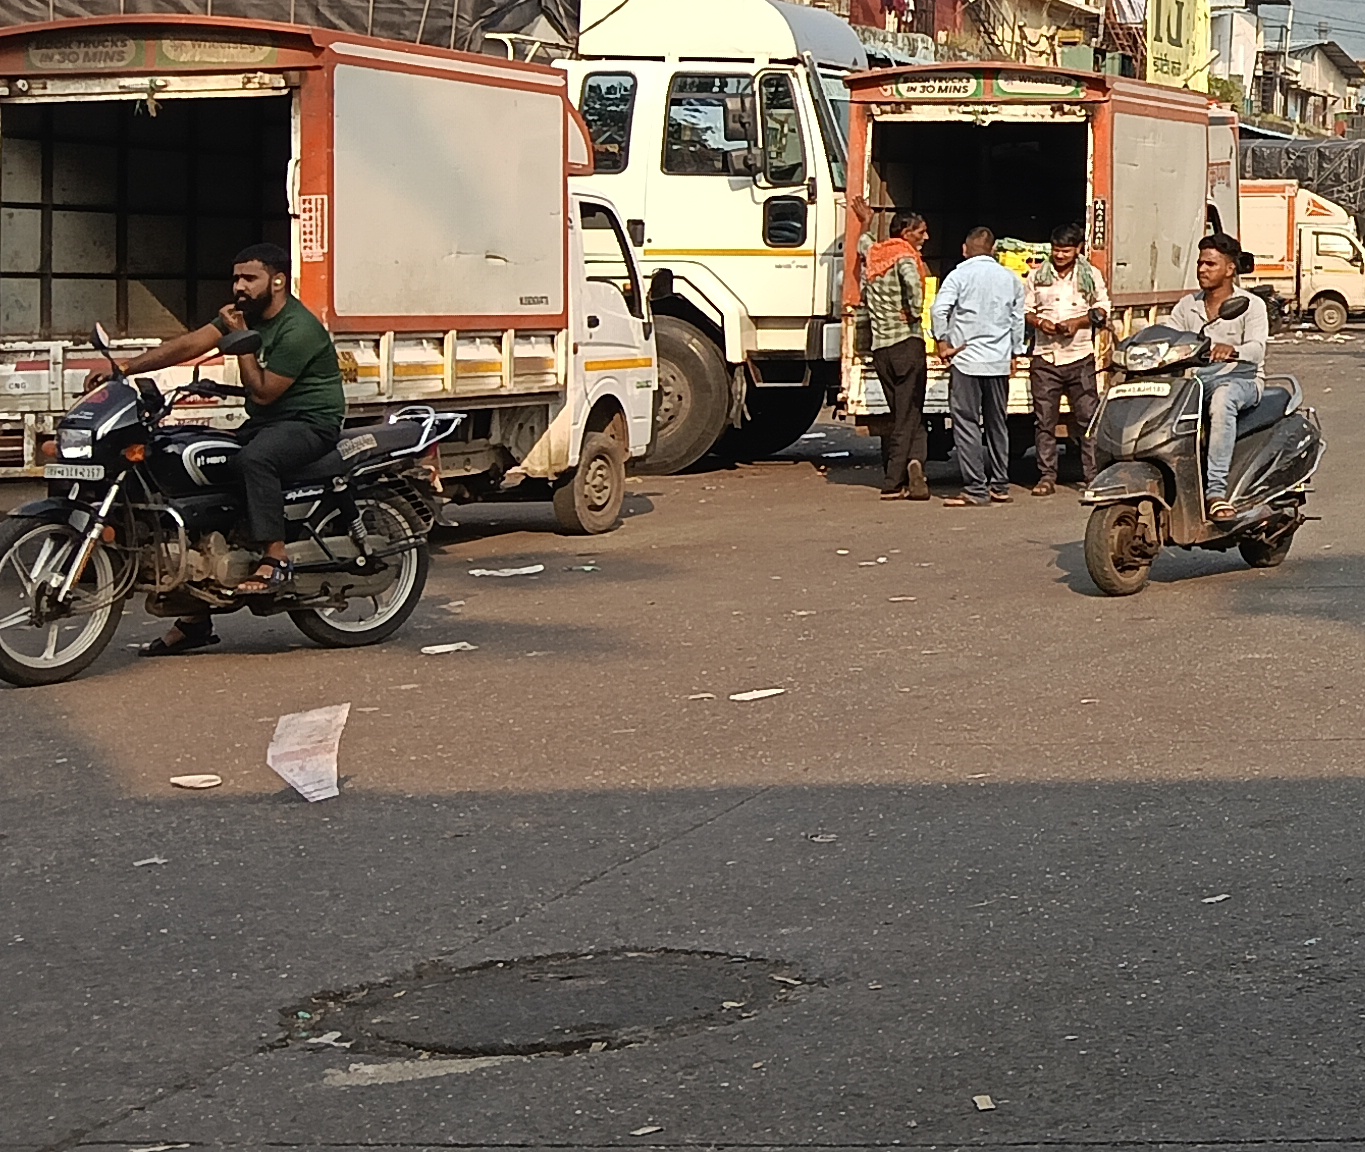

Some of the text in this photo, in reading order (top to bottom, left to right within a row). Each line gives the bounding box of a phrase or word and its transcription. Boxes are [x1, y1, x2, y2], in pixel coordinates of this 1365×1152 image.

[57, 51, 79, 64] 30
[82, 50, 127, 63] MINS
[933, 74, 971, 84] TRUCKS
[906, 84, 969, 94] IN 30 MINS
[8, 382, 27, 390] CNG
